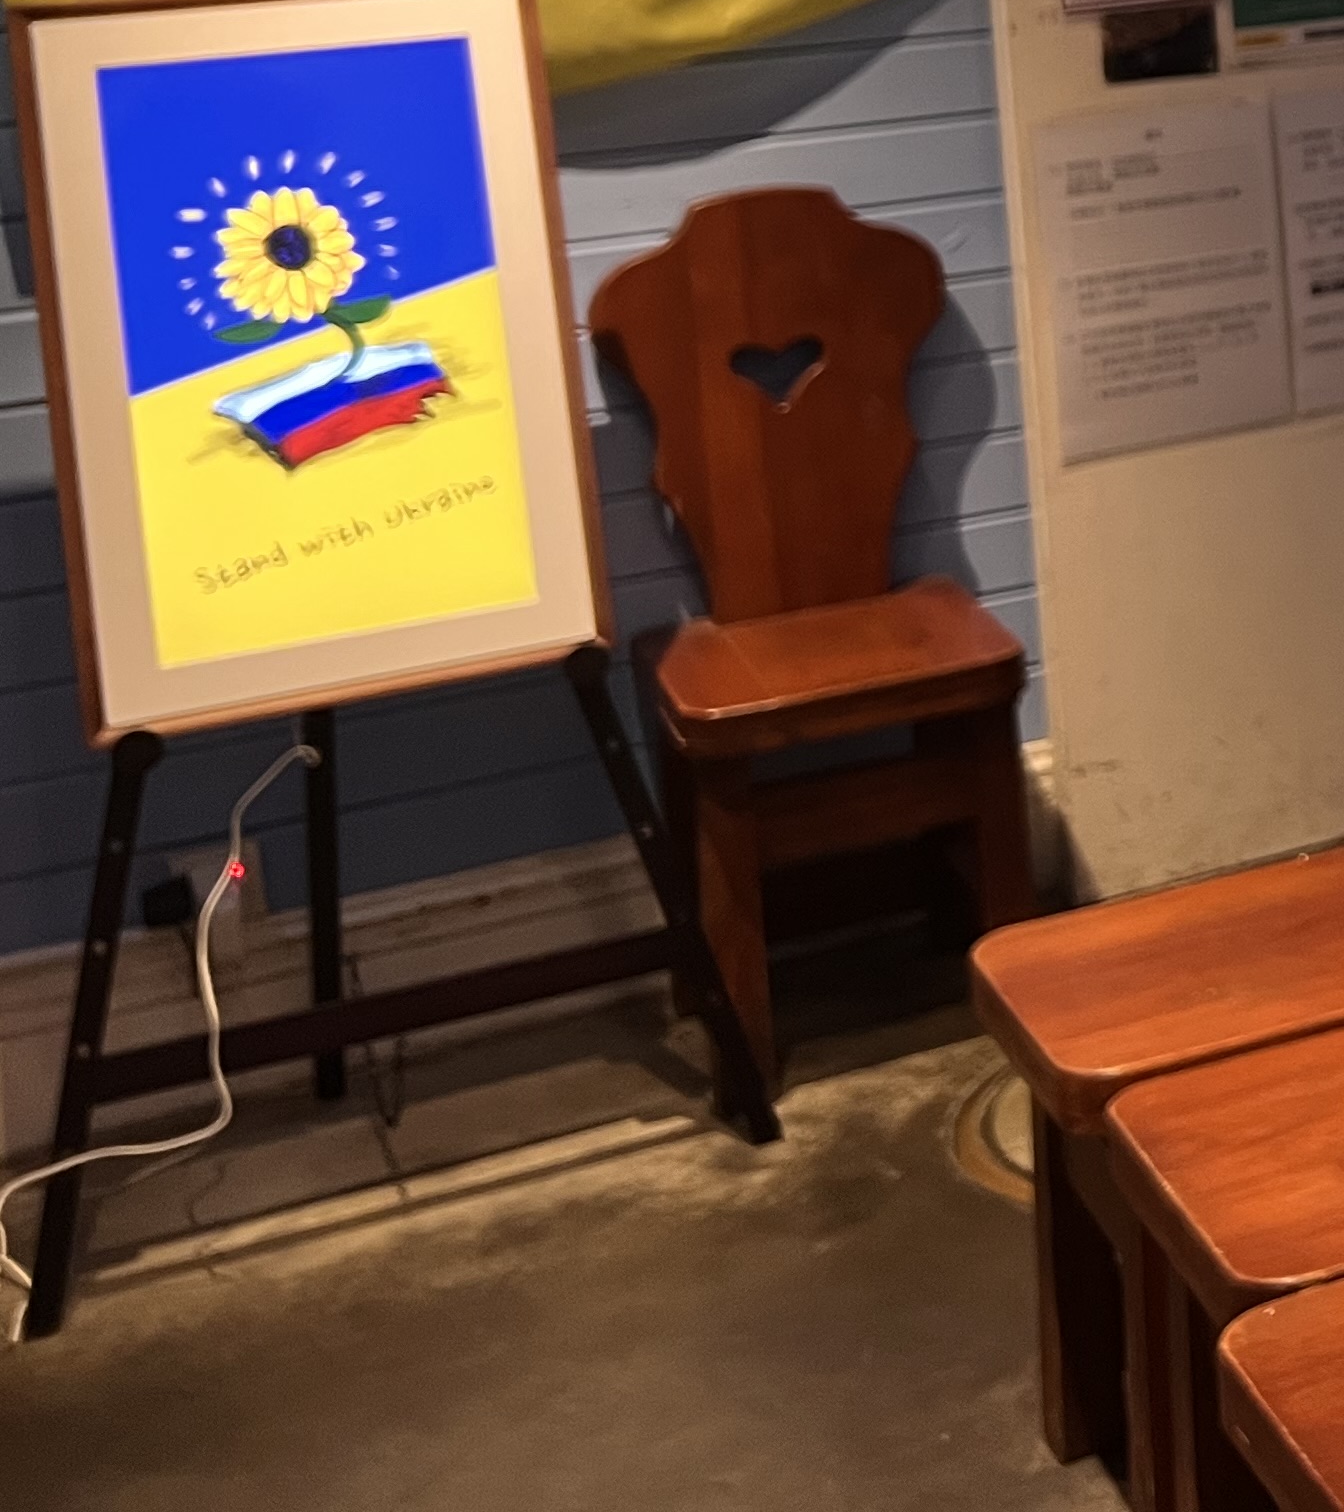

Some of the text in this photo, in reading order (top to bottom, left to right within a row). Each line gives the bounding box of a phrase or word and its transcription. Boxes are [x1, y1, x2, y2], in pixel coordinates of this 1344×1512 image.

[193, 475, 498, 595] Stand with Ukraine
